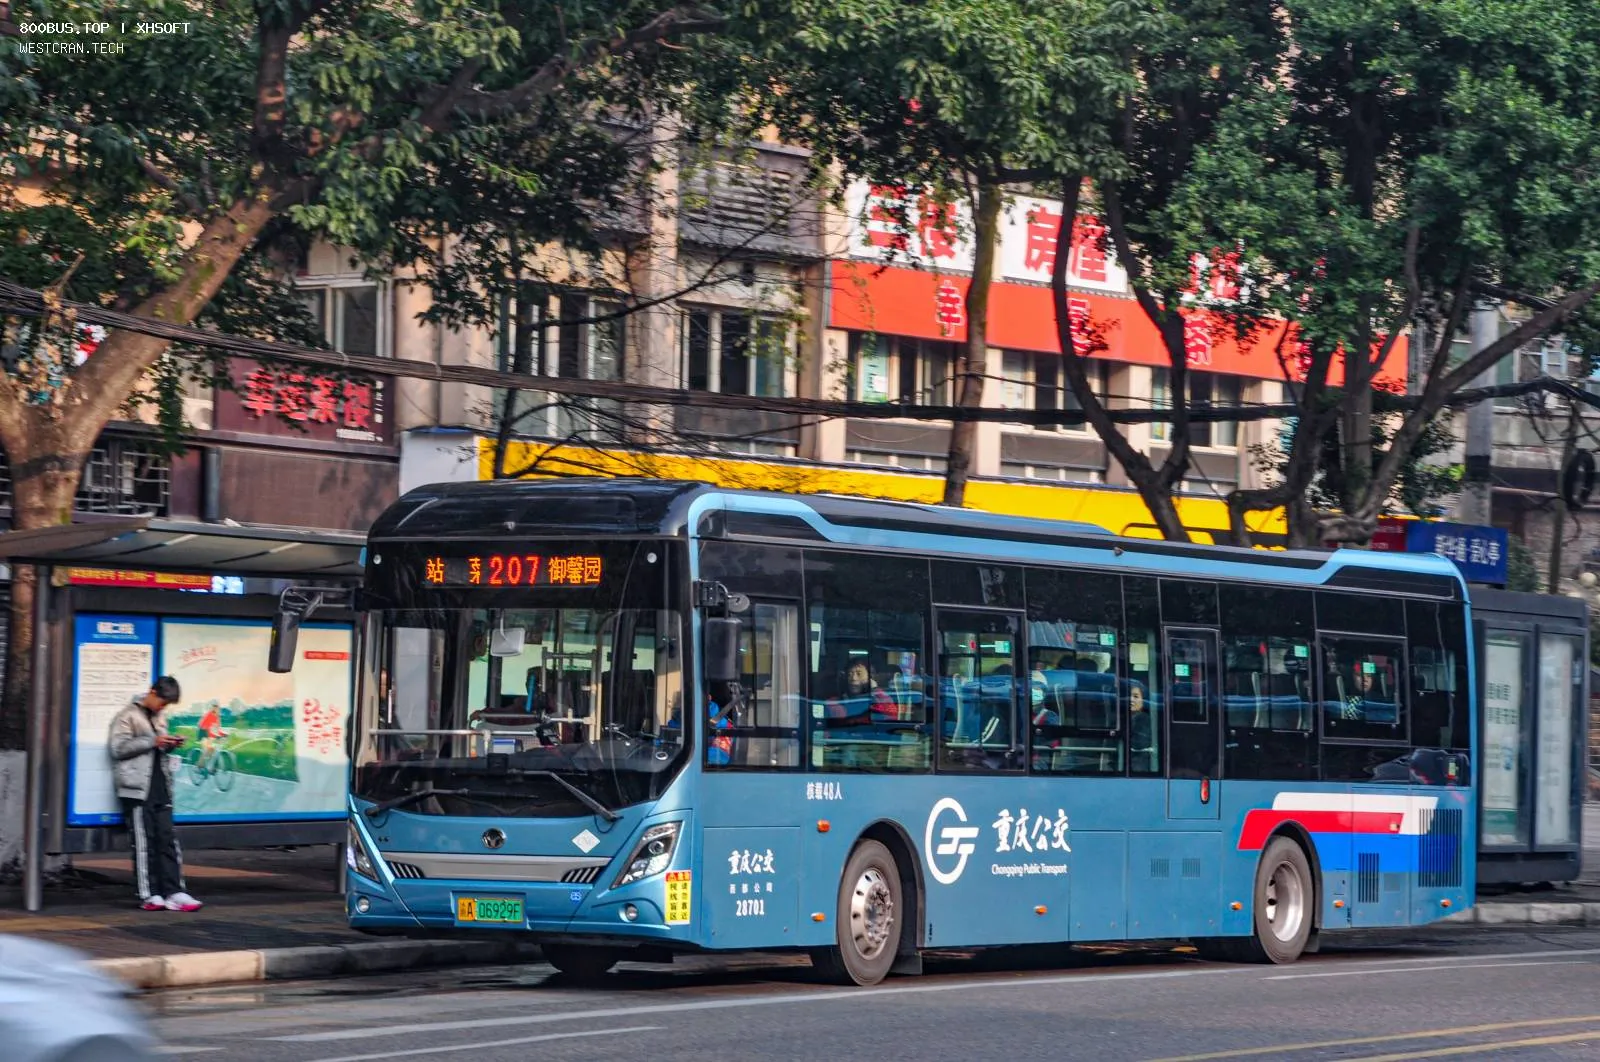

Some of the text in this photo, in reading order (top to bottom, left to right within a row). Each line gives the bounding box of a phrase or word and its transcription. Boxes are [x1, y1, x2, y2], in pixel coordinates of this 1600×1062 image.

[488, 556, 540, 585] 207
[549, 556, 601, 584] 御馨园
[806, 781, 843, 801] 核载48人
[992, 808, 1072, 853] 重庆公交
[727, 848, 776, 875] 重庆公交
[1023, 863, 1041, 875] Public
[1041, 863, 1068, 876] Transport
[736, 899, 765, 917] 28701
